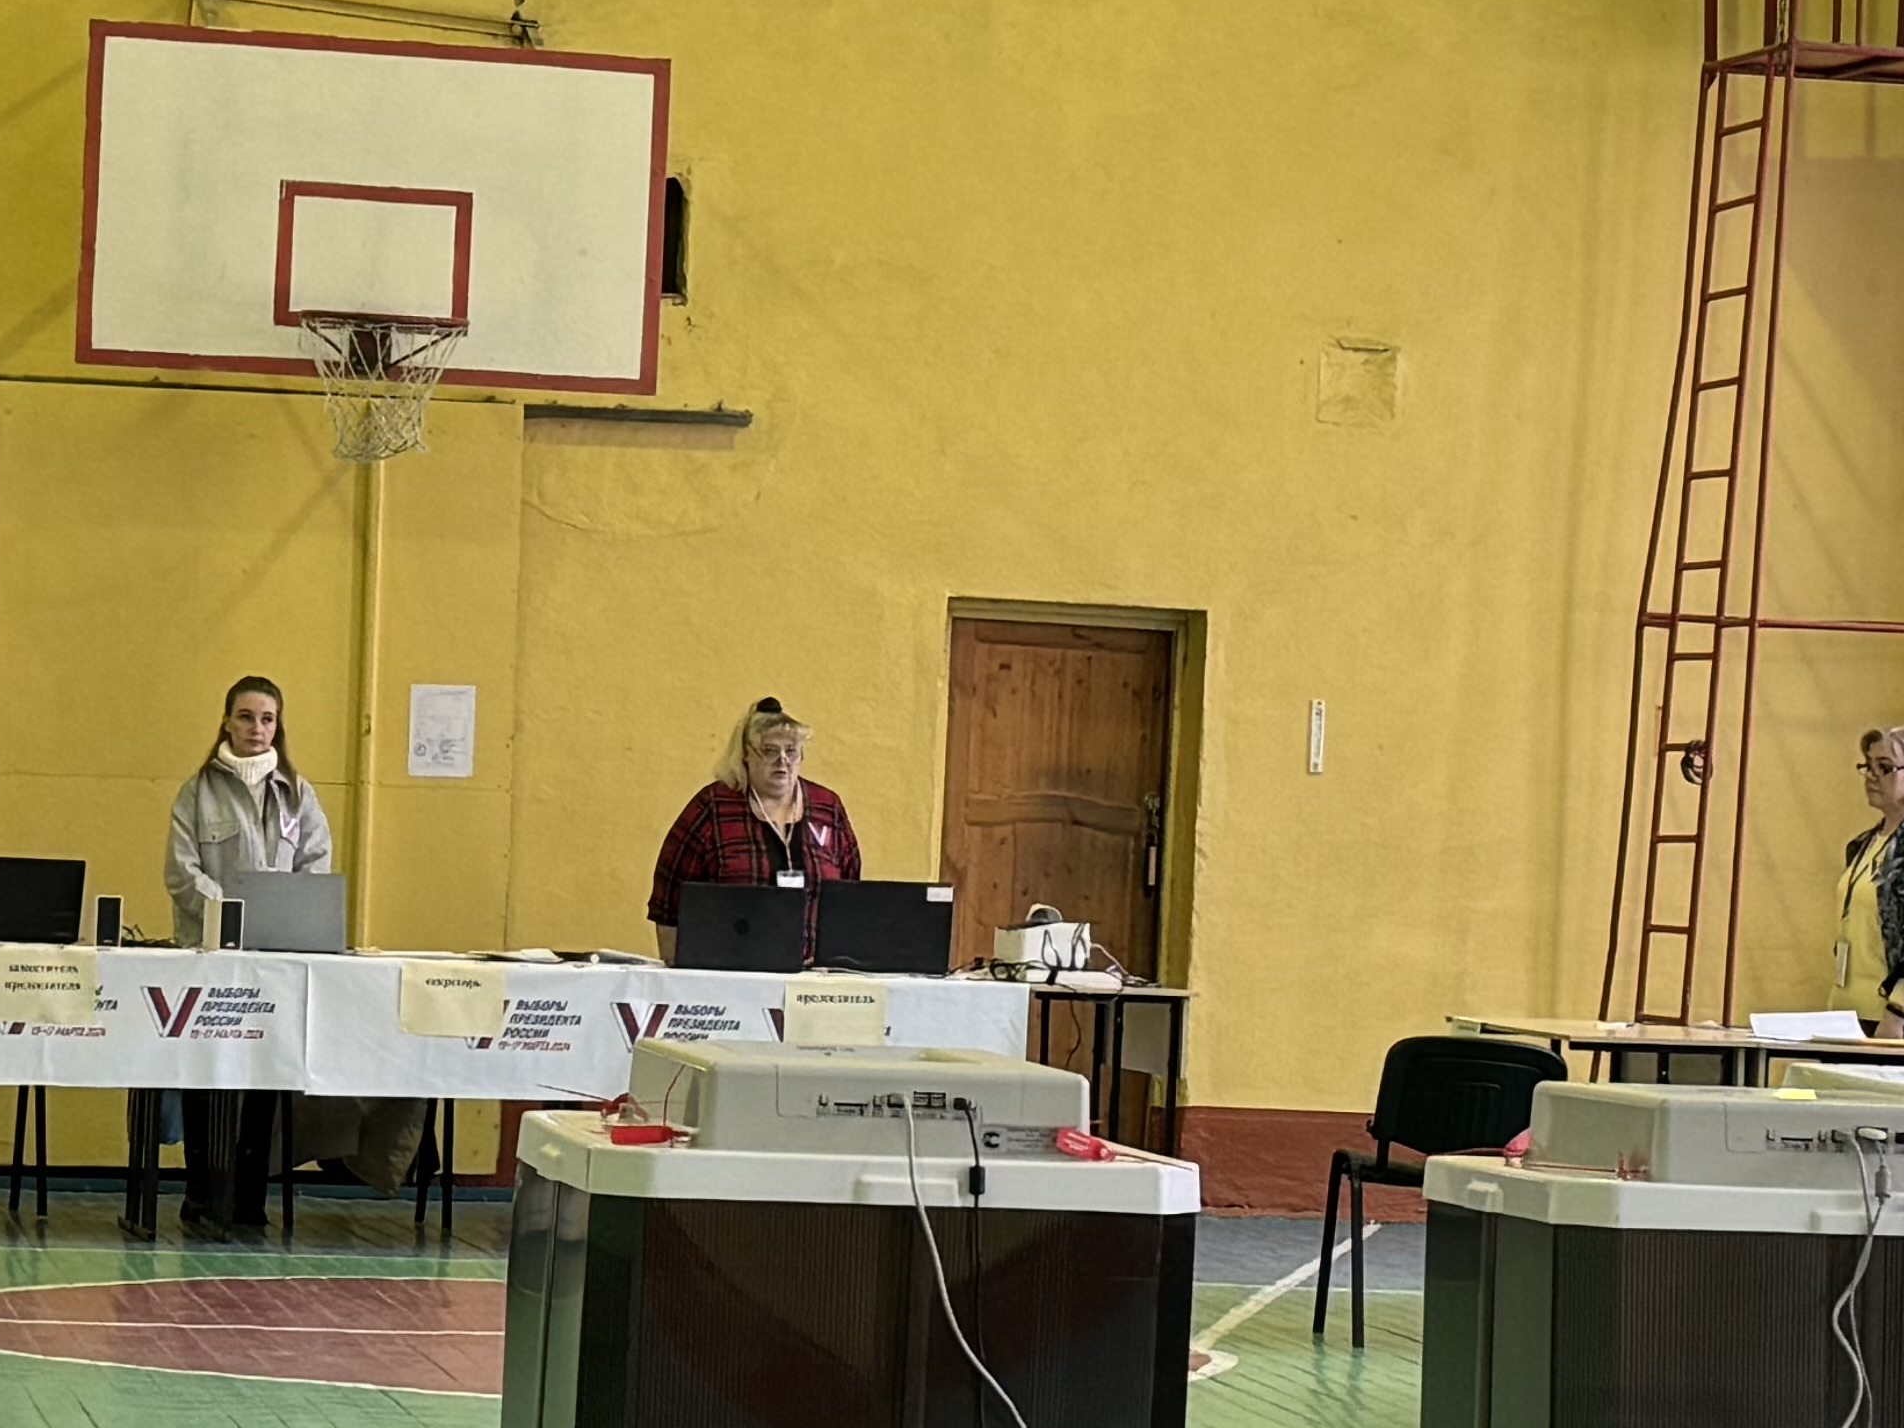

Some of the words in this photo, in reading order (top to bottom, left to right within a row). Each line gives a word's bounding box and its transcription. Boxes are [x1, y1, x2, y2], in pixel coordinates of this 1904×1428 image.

[515, 998, 568, 1011] ВЫБОРЫ
[674, 1003, 726, 1015] ВЫБОРЫ
[667, 1017, 741, 1030] ПРЕЗИДЕНТА
